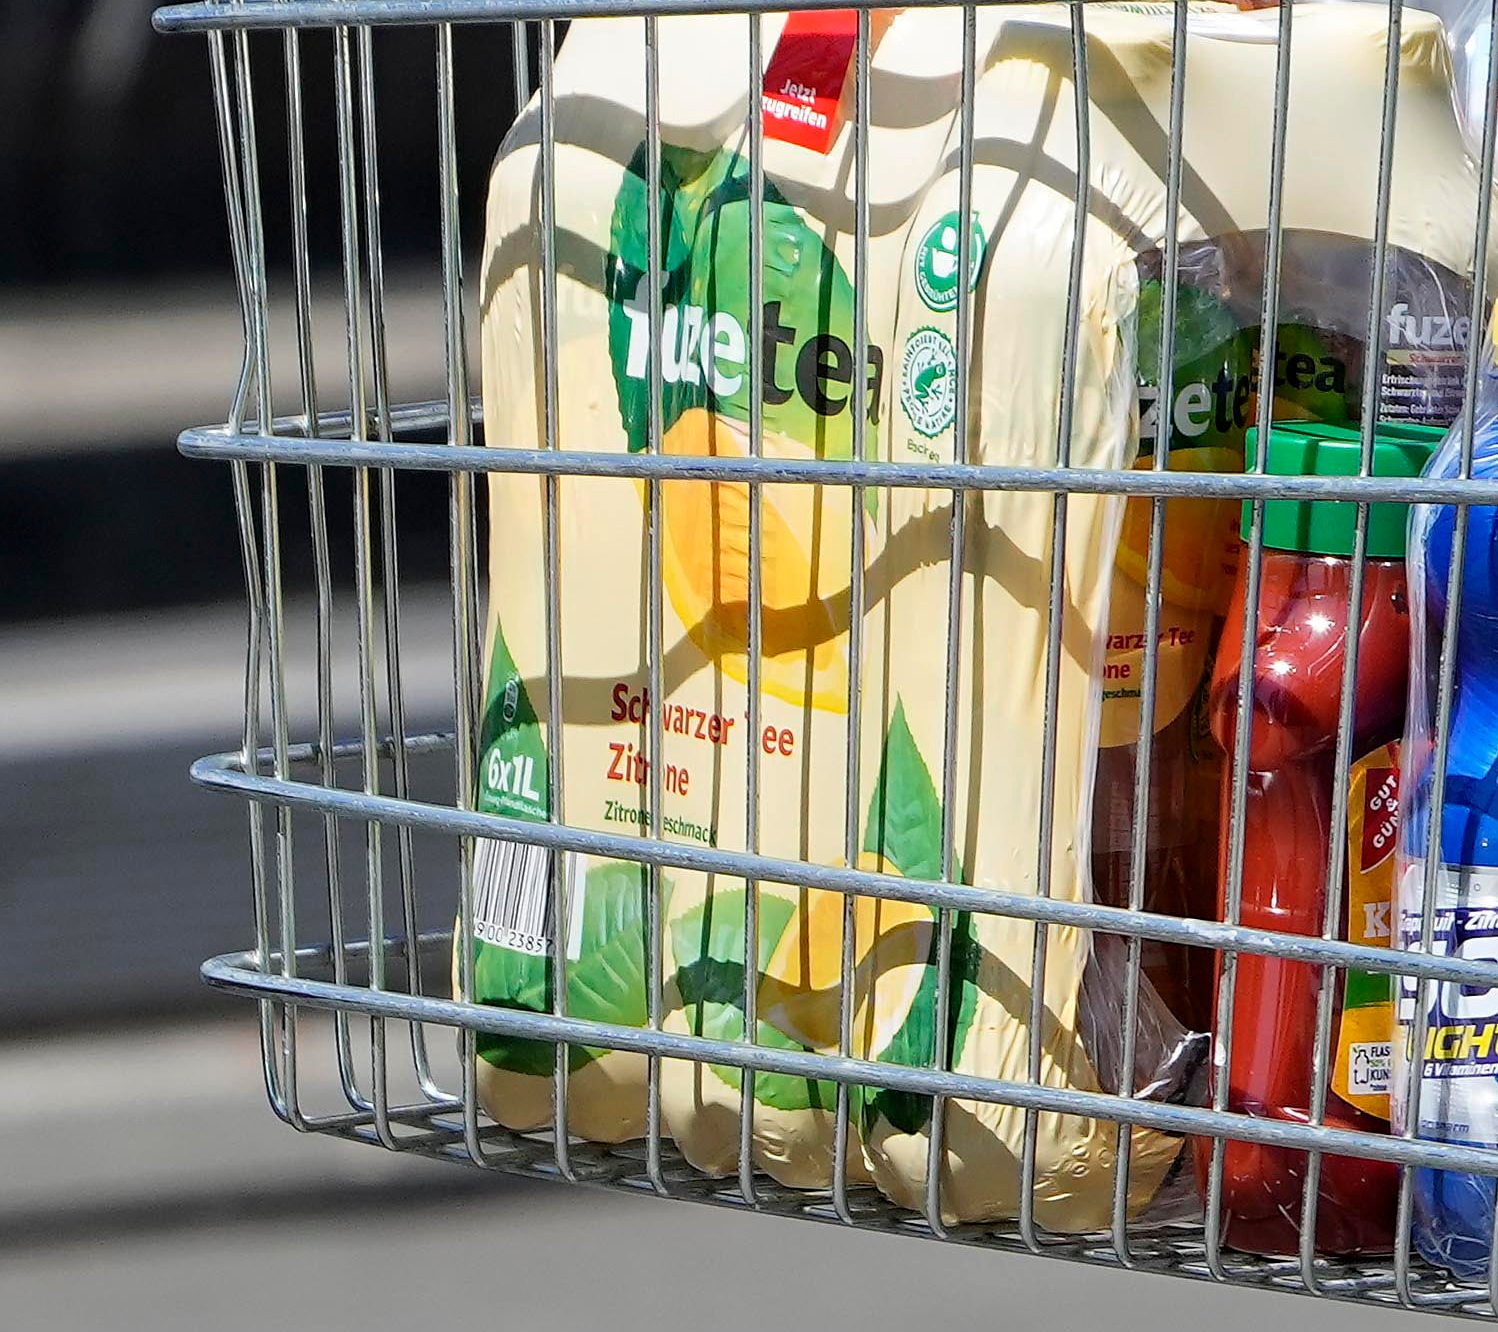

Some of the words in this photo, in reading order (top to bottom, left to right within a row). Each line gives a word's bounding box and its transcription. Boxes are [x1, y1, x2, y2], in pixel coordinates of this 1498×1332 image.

[780, 79, 815, 104] Jetzt
[762, 97, 827, 131] zugreifen
[487, 747, 540, 802] 6x1L
